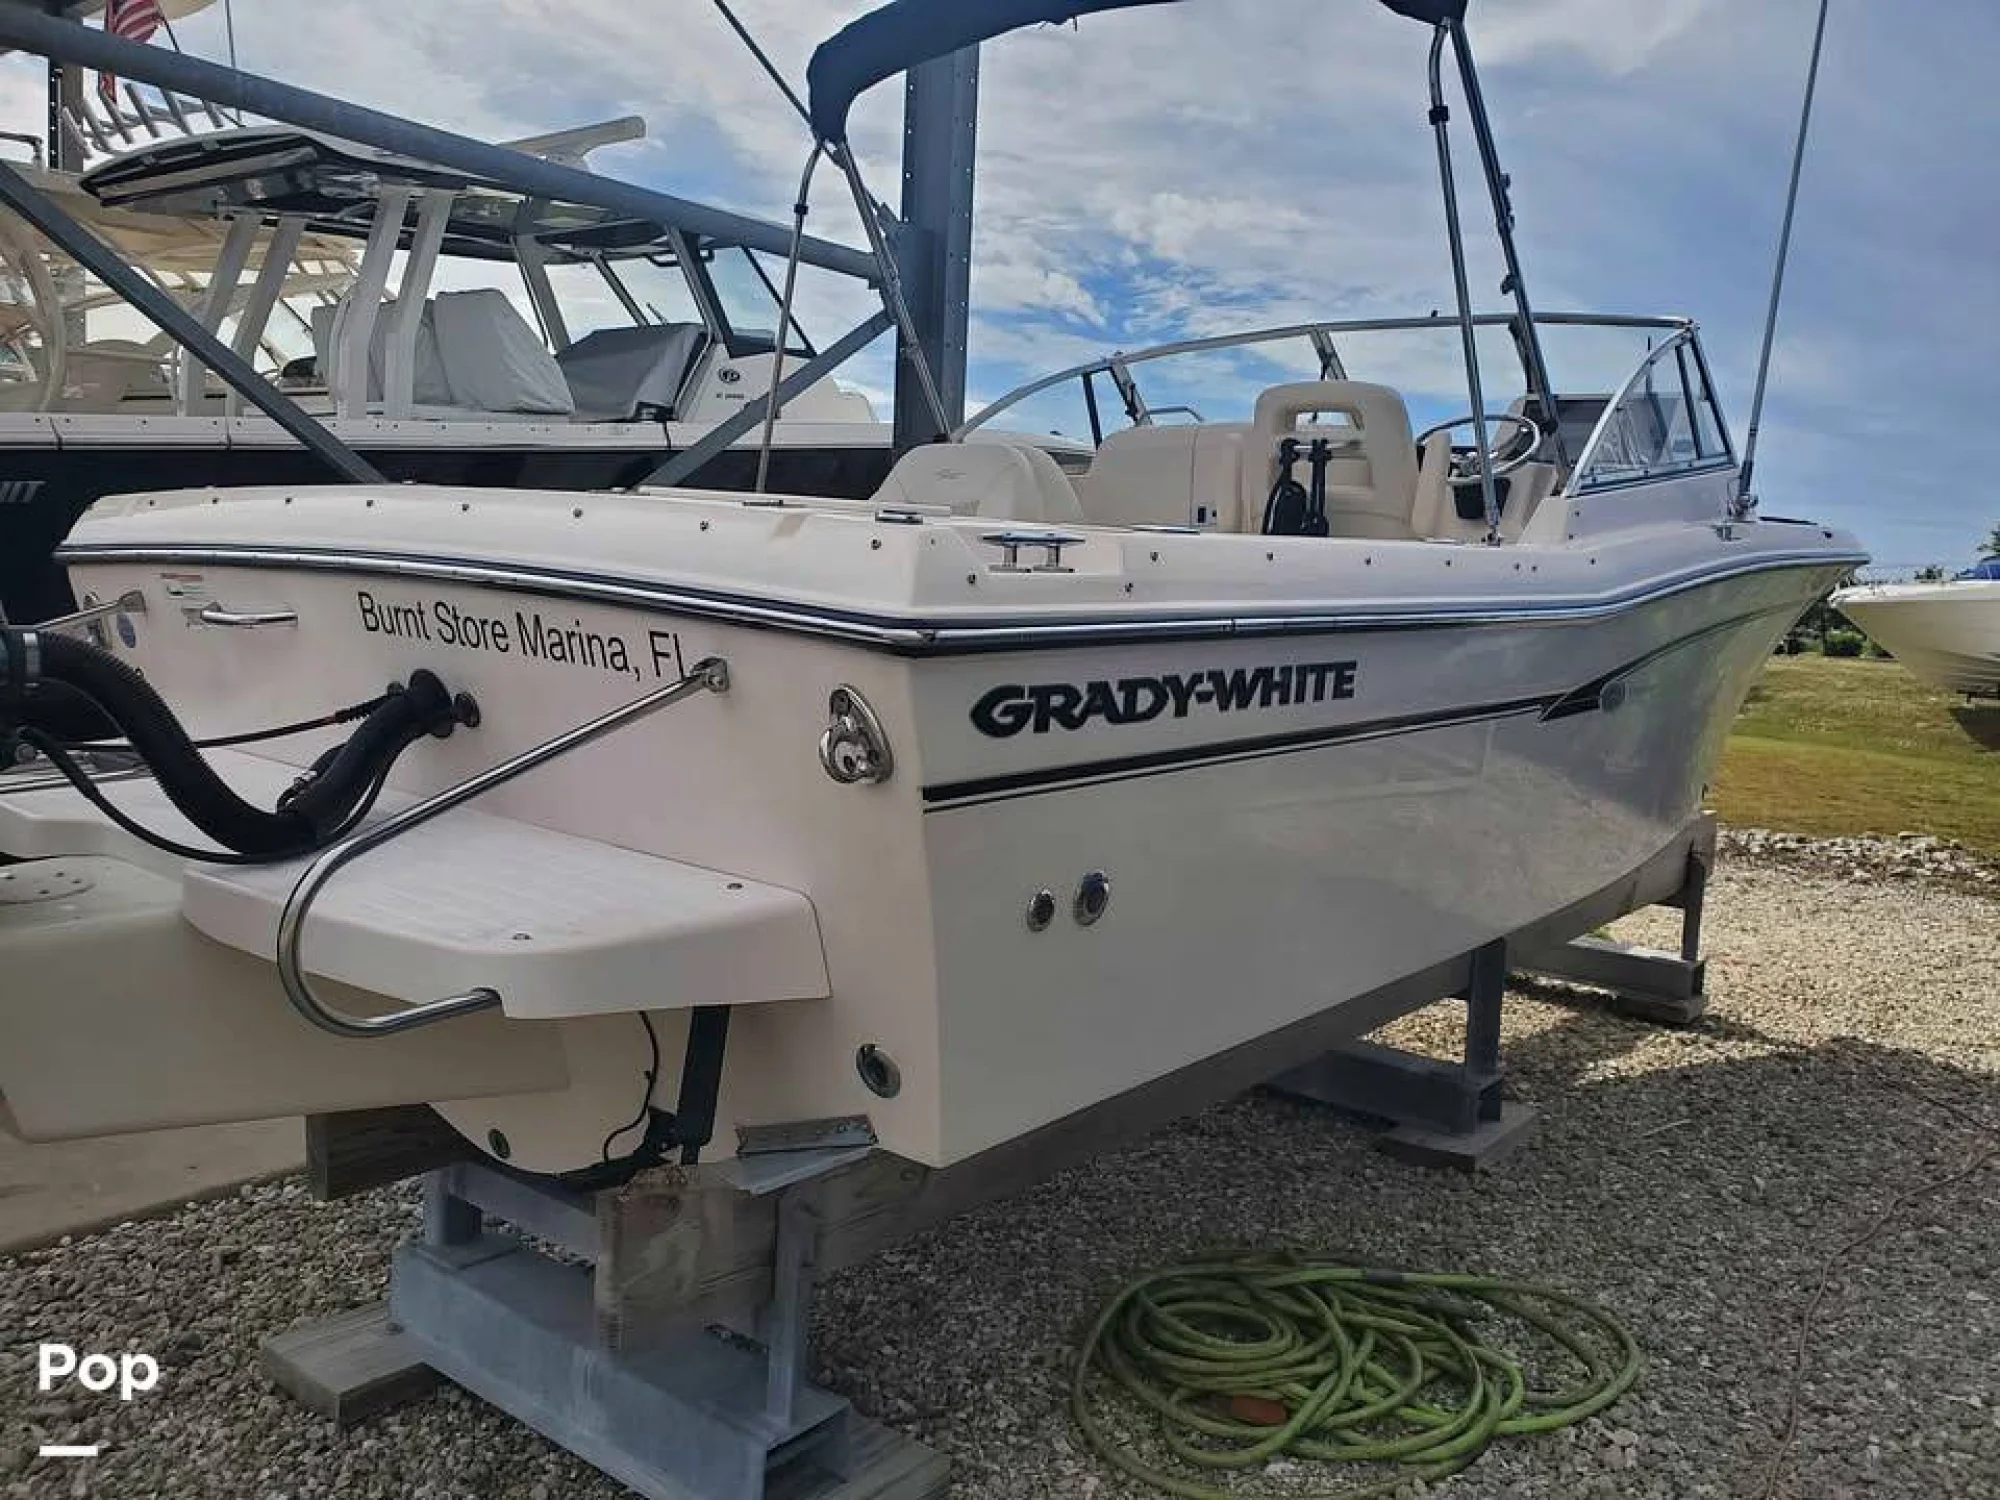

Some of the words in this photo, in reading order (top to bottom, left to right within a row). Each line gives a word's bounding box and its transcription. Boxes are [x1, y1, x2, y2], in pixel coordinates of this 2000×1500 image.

[357, 590, 431, 641] Burnt
[434, 600, 510, 653] Store
[516, 611, 641, 682] Marina,
[969, 659, 1358, 738] GRADY-WHITE
